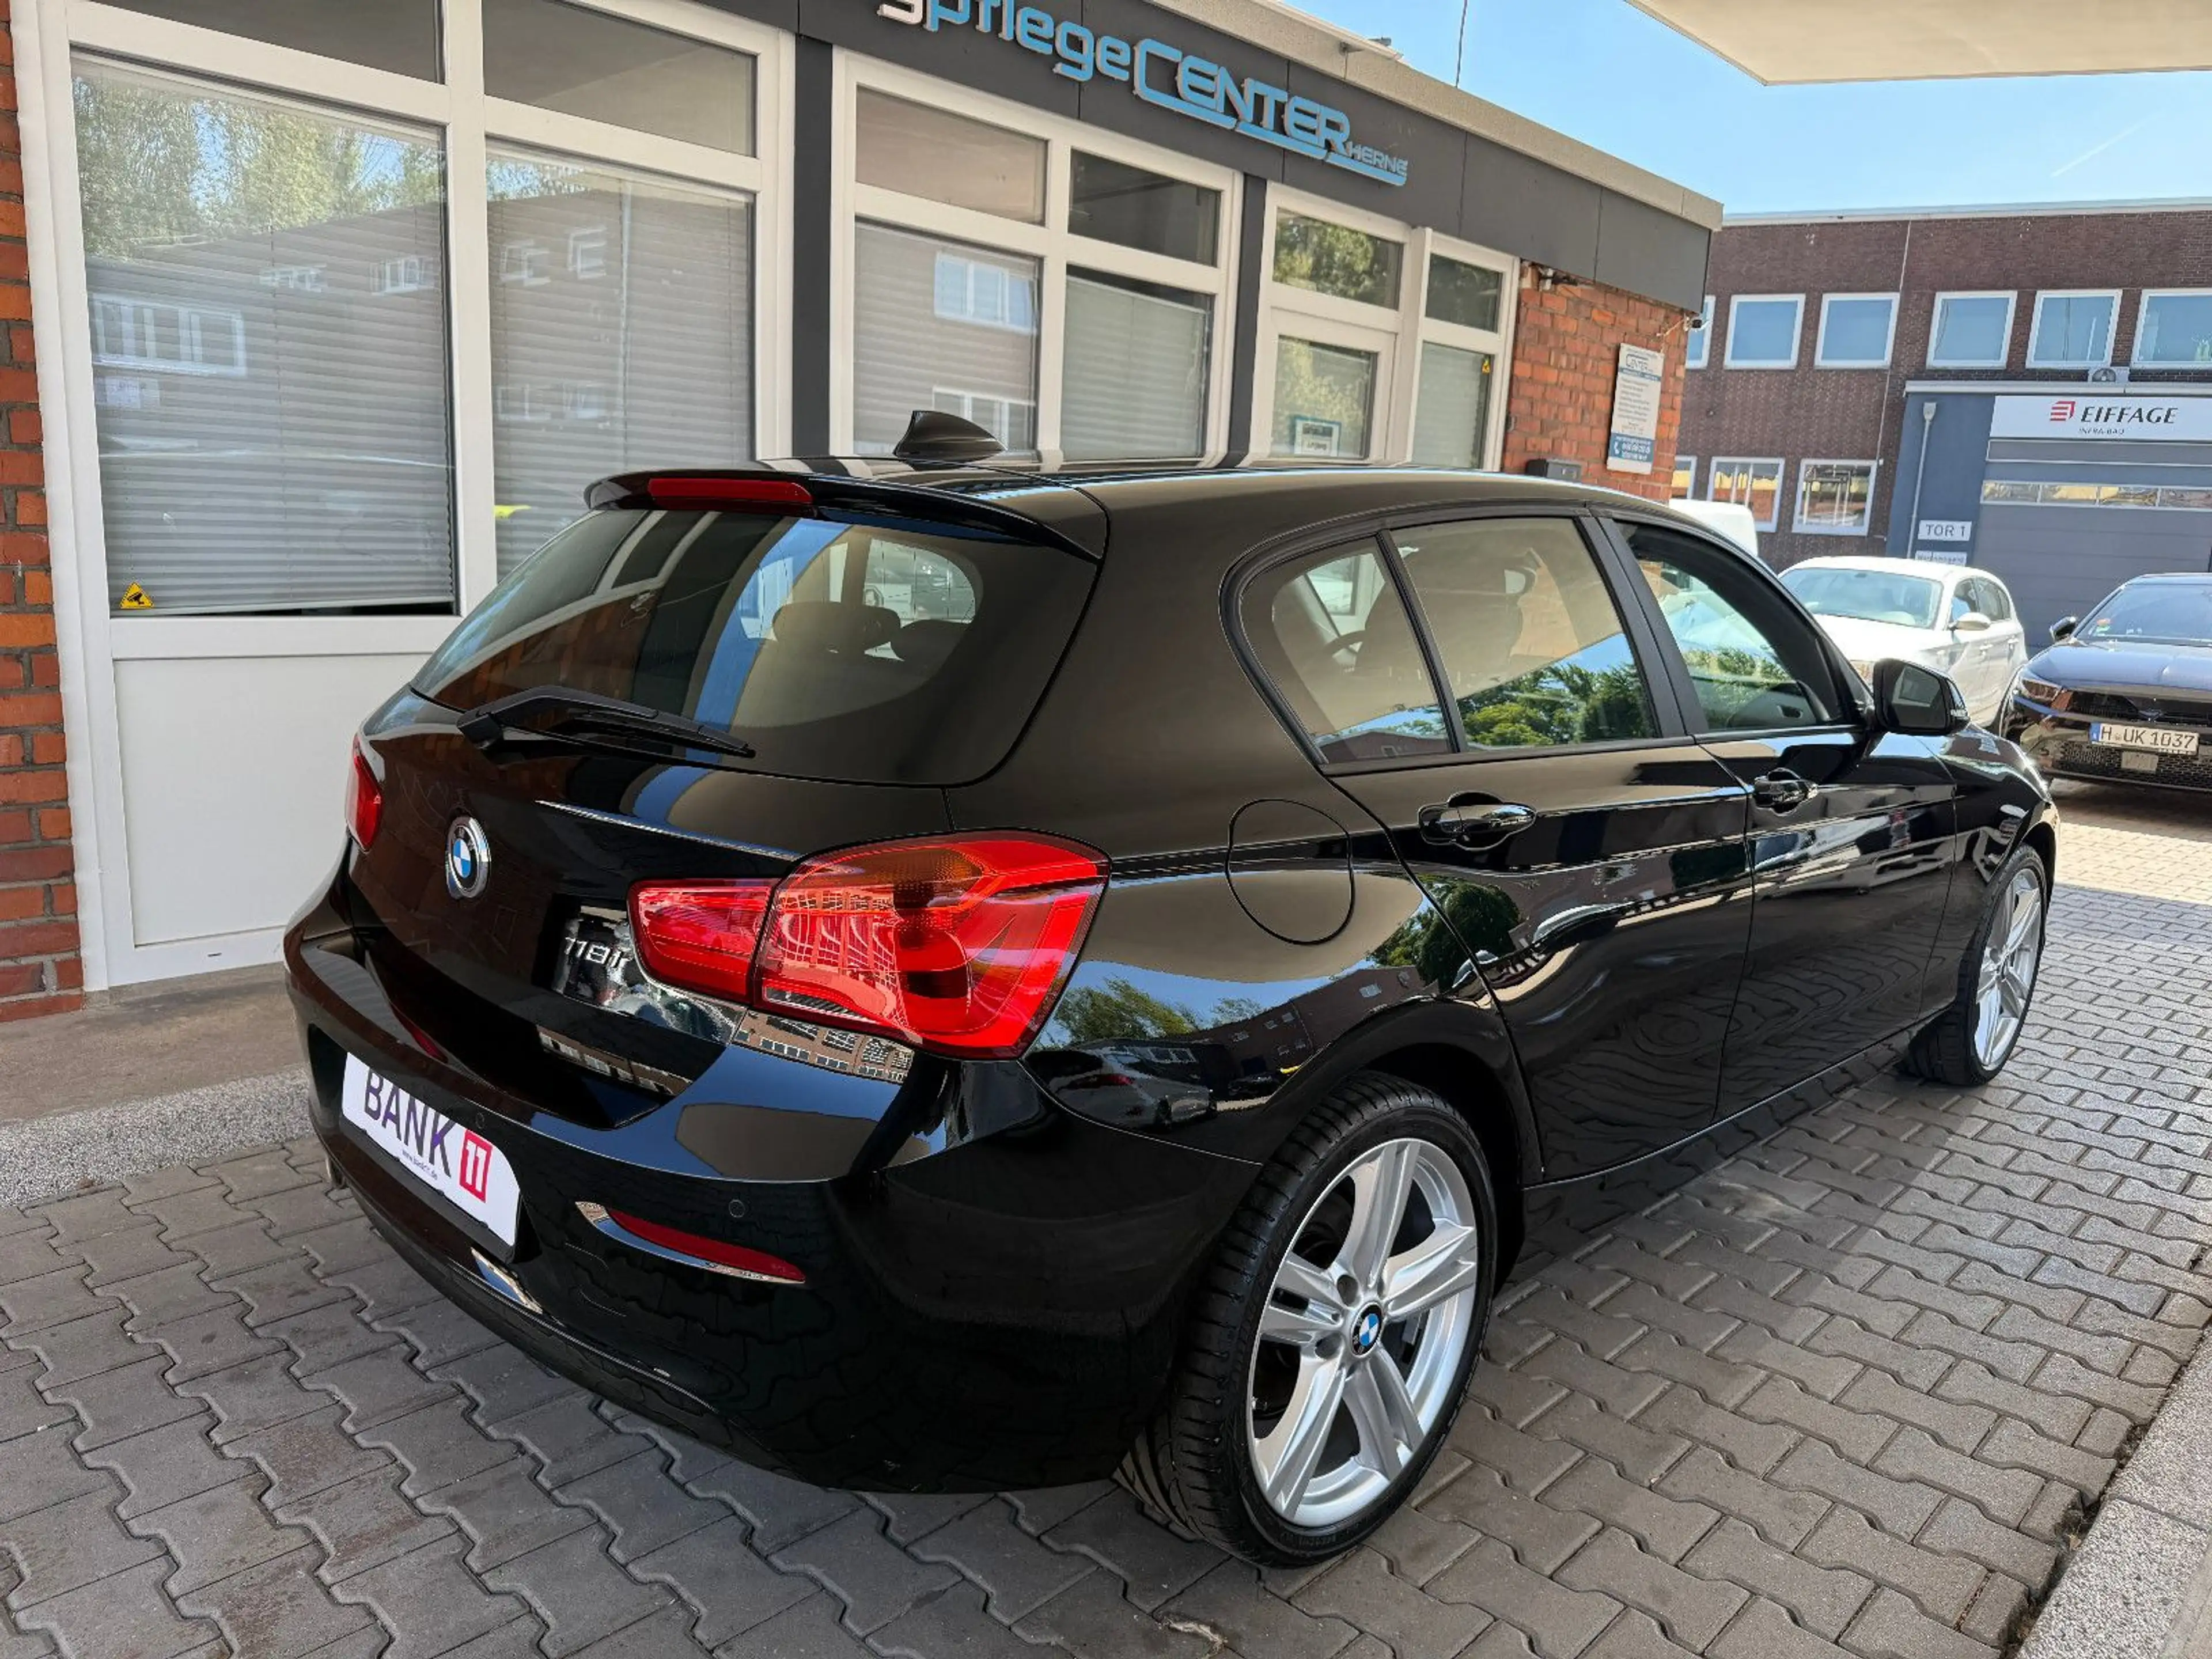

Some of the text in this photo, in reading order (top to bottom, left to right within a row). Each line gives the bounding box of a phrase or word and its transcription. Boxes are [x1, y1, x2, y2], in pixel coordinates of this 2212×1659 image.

[1349, 141, 1408, 175] HERNE
[2081, 406, 2179, 424] EIFFAGE
[1925, 524, 1966, 537] TOR 1
[2102, 726, 2195, 749] H UK 1037
[363, 1067, 456, 1179] BANK
